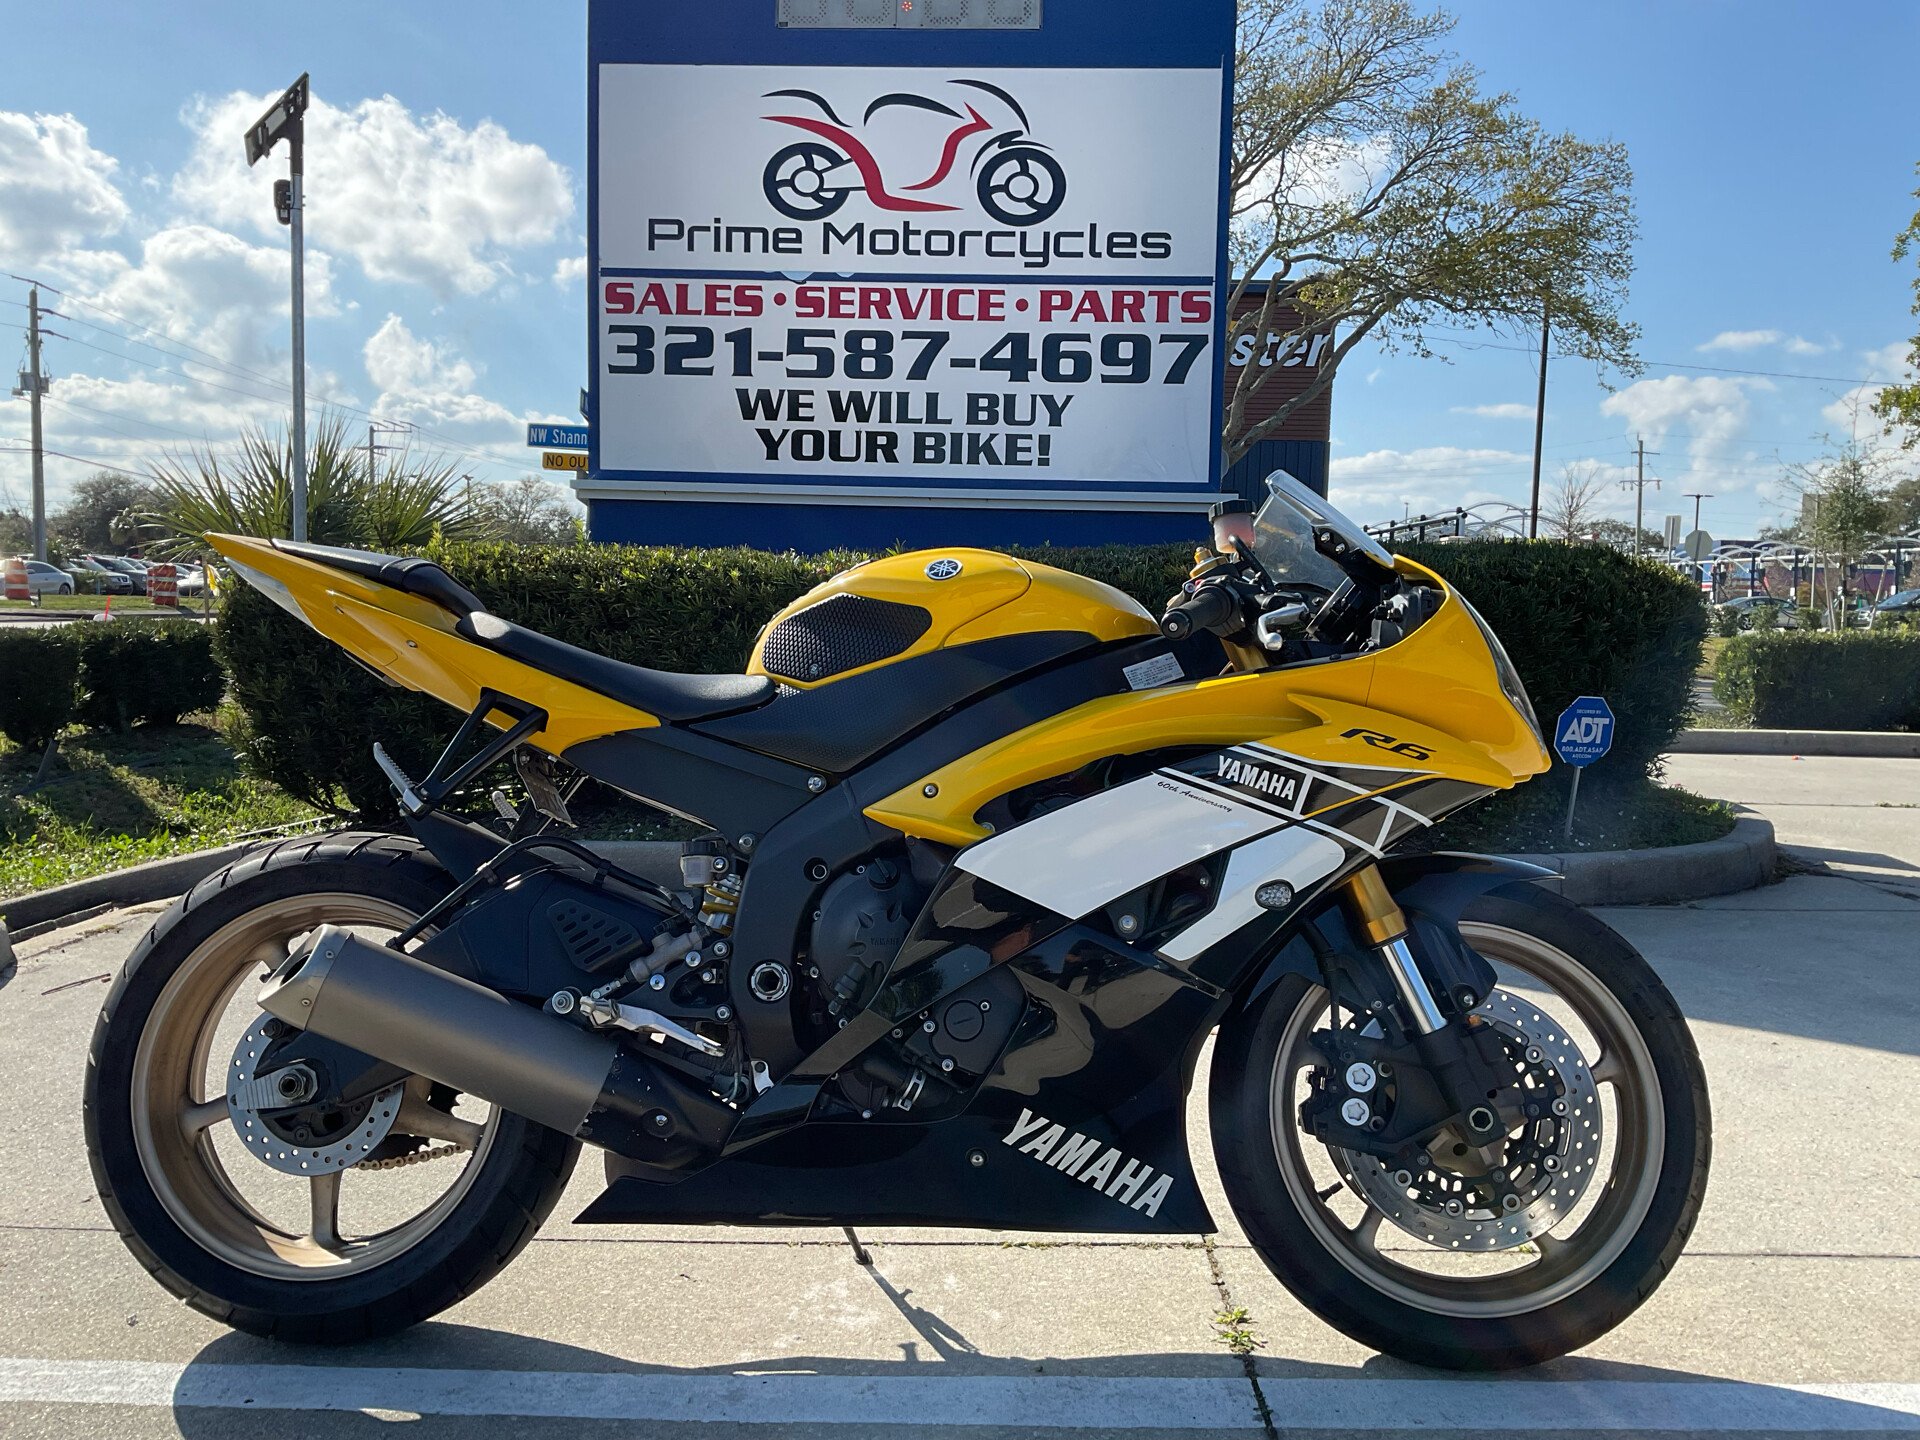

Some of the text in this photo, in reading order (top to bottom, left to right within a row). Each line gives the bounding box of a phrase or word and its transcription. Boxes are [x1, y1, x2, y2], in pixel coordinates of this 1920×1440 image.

[648, 217, 1172, 268] Prime Motorcycles
[604, 281, 1212, 324] SALES SERVICE PARTS
[607, 324, 1210, 385] 321-587-4697
[735, 388, 1075, 428] WE WILL BUY
[530, 427, 547, 443] NW
[754, 428, 1052, 467] YOUR BIKE!
[546, 454, 588, 468] NO OU
[1339, 727, 1437, 761] R6
[1561, 717, 1610, 744] ADT
[1157, 781, 1233, 813] 60th Anniversary
[1217, 754, 1296, 801] YAMAHA
[1002, 1107, 1174, 1218] YAMAHA
